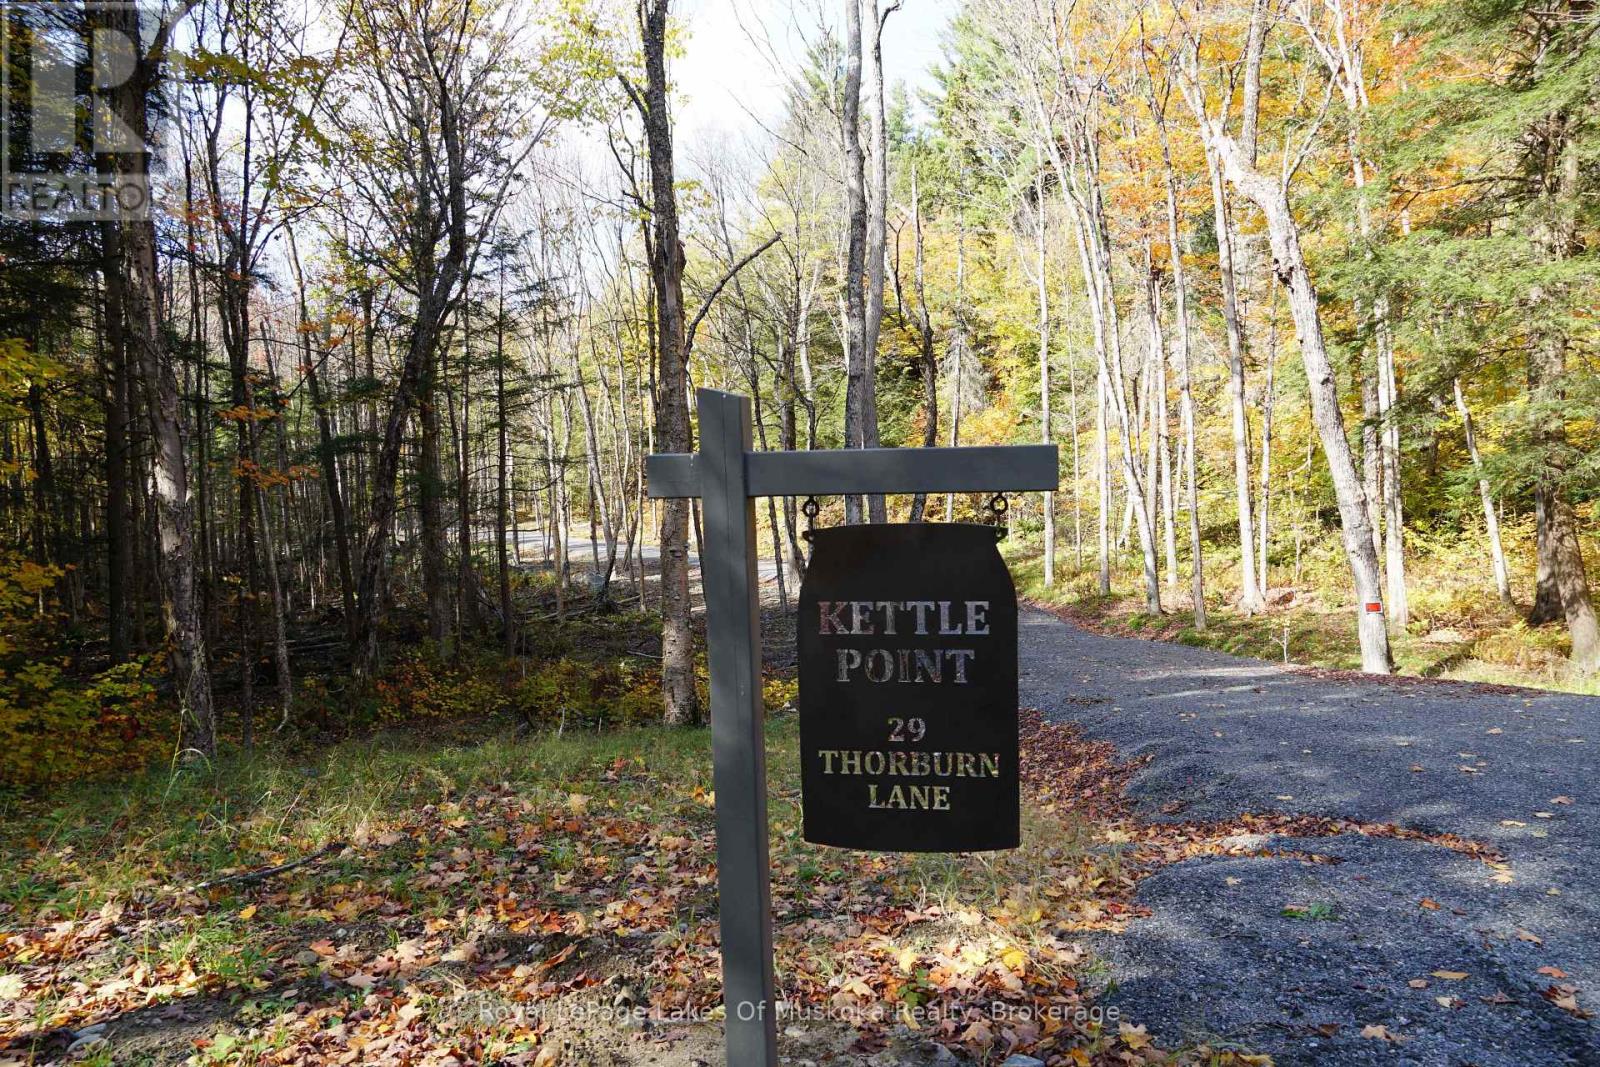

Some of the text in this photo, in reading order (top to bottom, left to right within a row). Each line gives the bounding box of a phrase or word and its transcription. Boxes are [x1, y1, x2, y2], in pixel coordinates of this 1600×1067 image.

[817, 601, 990, 635] KETTLE
[836, 649, 975, 683] POINT
[887, 717, 926, 742] 29
[818, 750, 1000, 778] THORBURN
[868, 784, 951, 811] LANE
